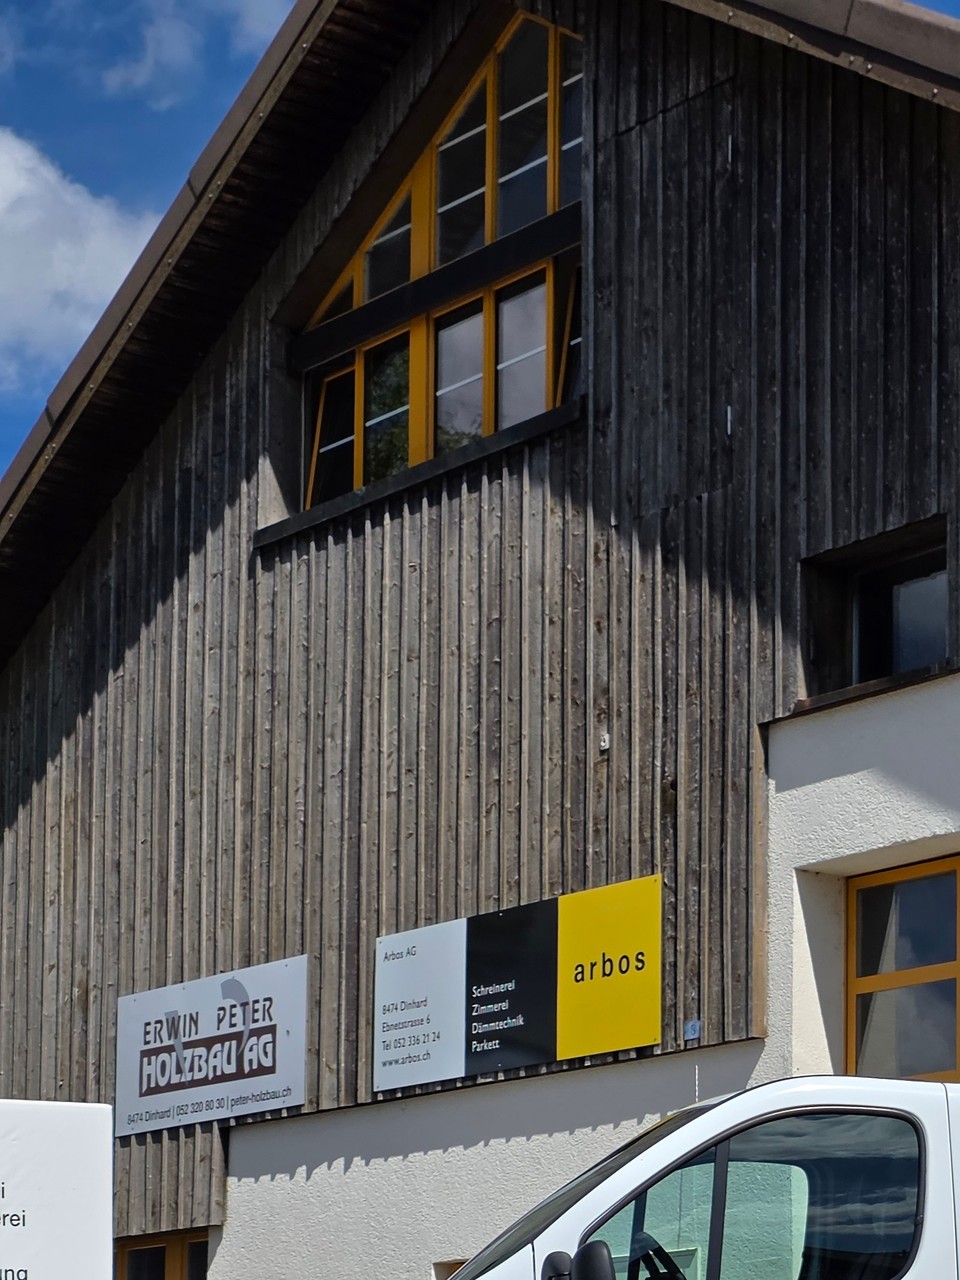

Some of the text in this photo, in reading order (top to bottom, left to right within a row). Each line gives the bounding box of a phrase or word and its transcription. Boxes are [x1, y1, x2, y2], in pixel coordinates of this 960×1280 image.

[383, 946, 416, 962] Arbos AG
[573, 951, 646, 983] arbos
[471, 979, 516, 998] Schreinerei
[382, 996, 428, 1015] 8474 Dinhard
[471, 999, 509, 1016] Zimmerei
[143, 996, 274, 1046] ERWIN PETER
[382, 1017, 425, 1033] Ebnetstrasse
[471, 1014, 525, 1034] Dämmtechnik
[381, 1030, 441, 1052] Tel 052 336 21 24
[471, 1038, 500, 1053] Parkett
[142, 1033, 273, 1094] HOLZBAU AG
[381, 1050, 431, 1068] www.arbos.ch
[127, 1112, 143, 1126] 8474
[144, 1107, 171, 1122] Dinhard
[175, 1104, 188, 1117] 052
[190, 1101, 204, 1114] 320
[204, 1099, 214, 1111] 80
[215, 1097, 225, 1109] 30
[230, 1085, 292, 1112] peter-holzbau.ch
[0, 1209, 26, 1227] rei
